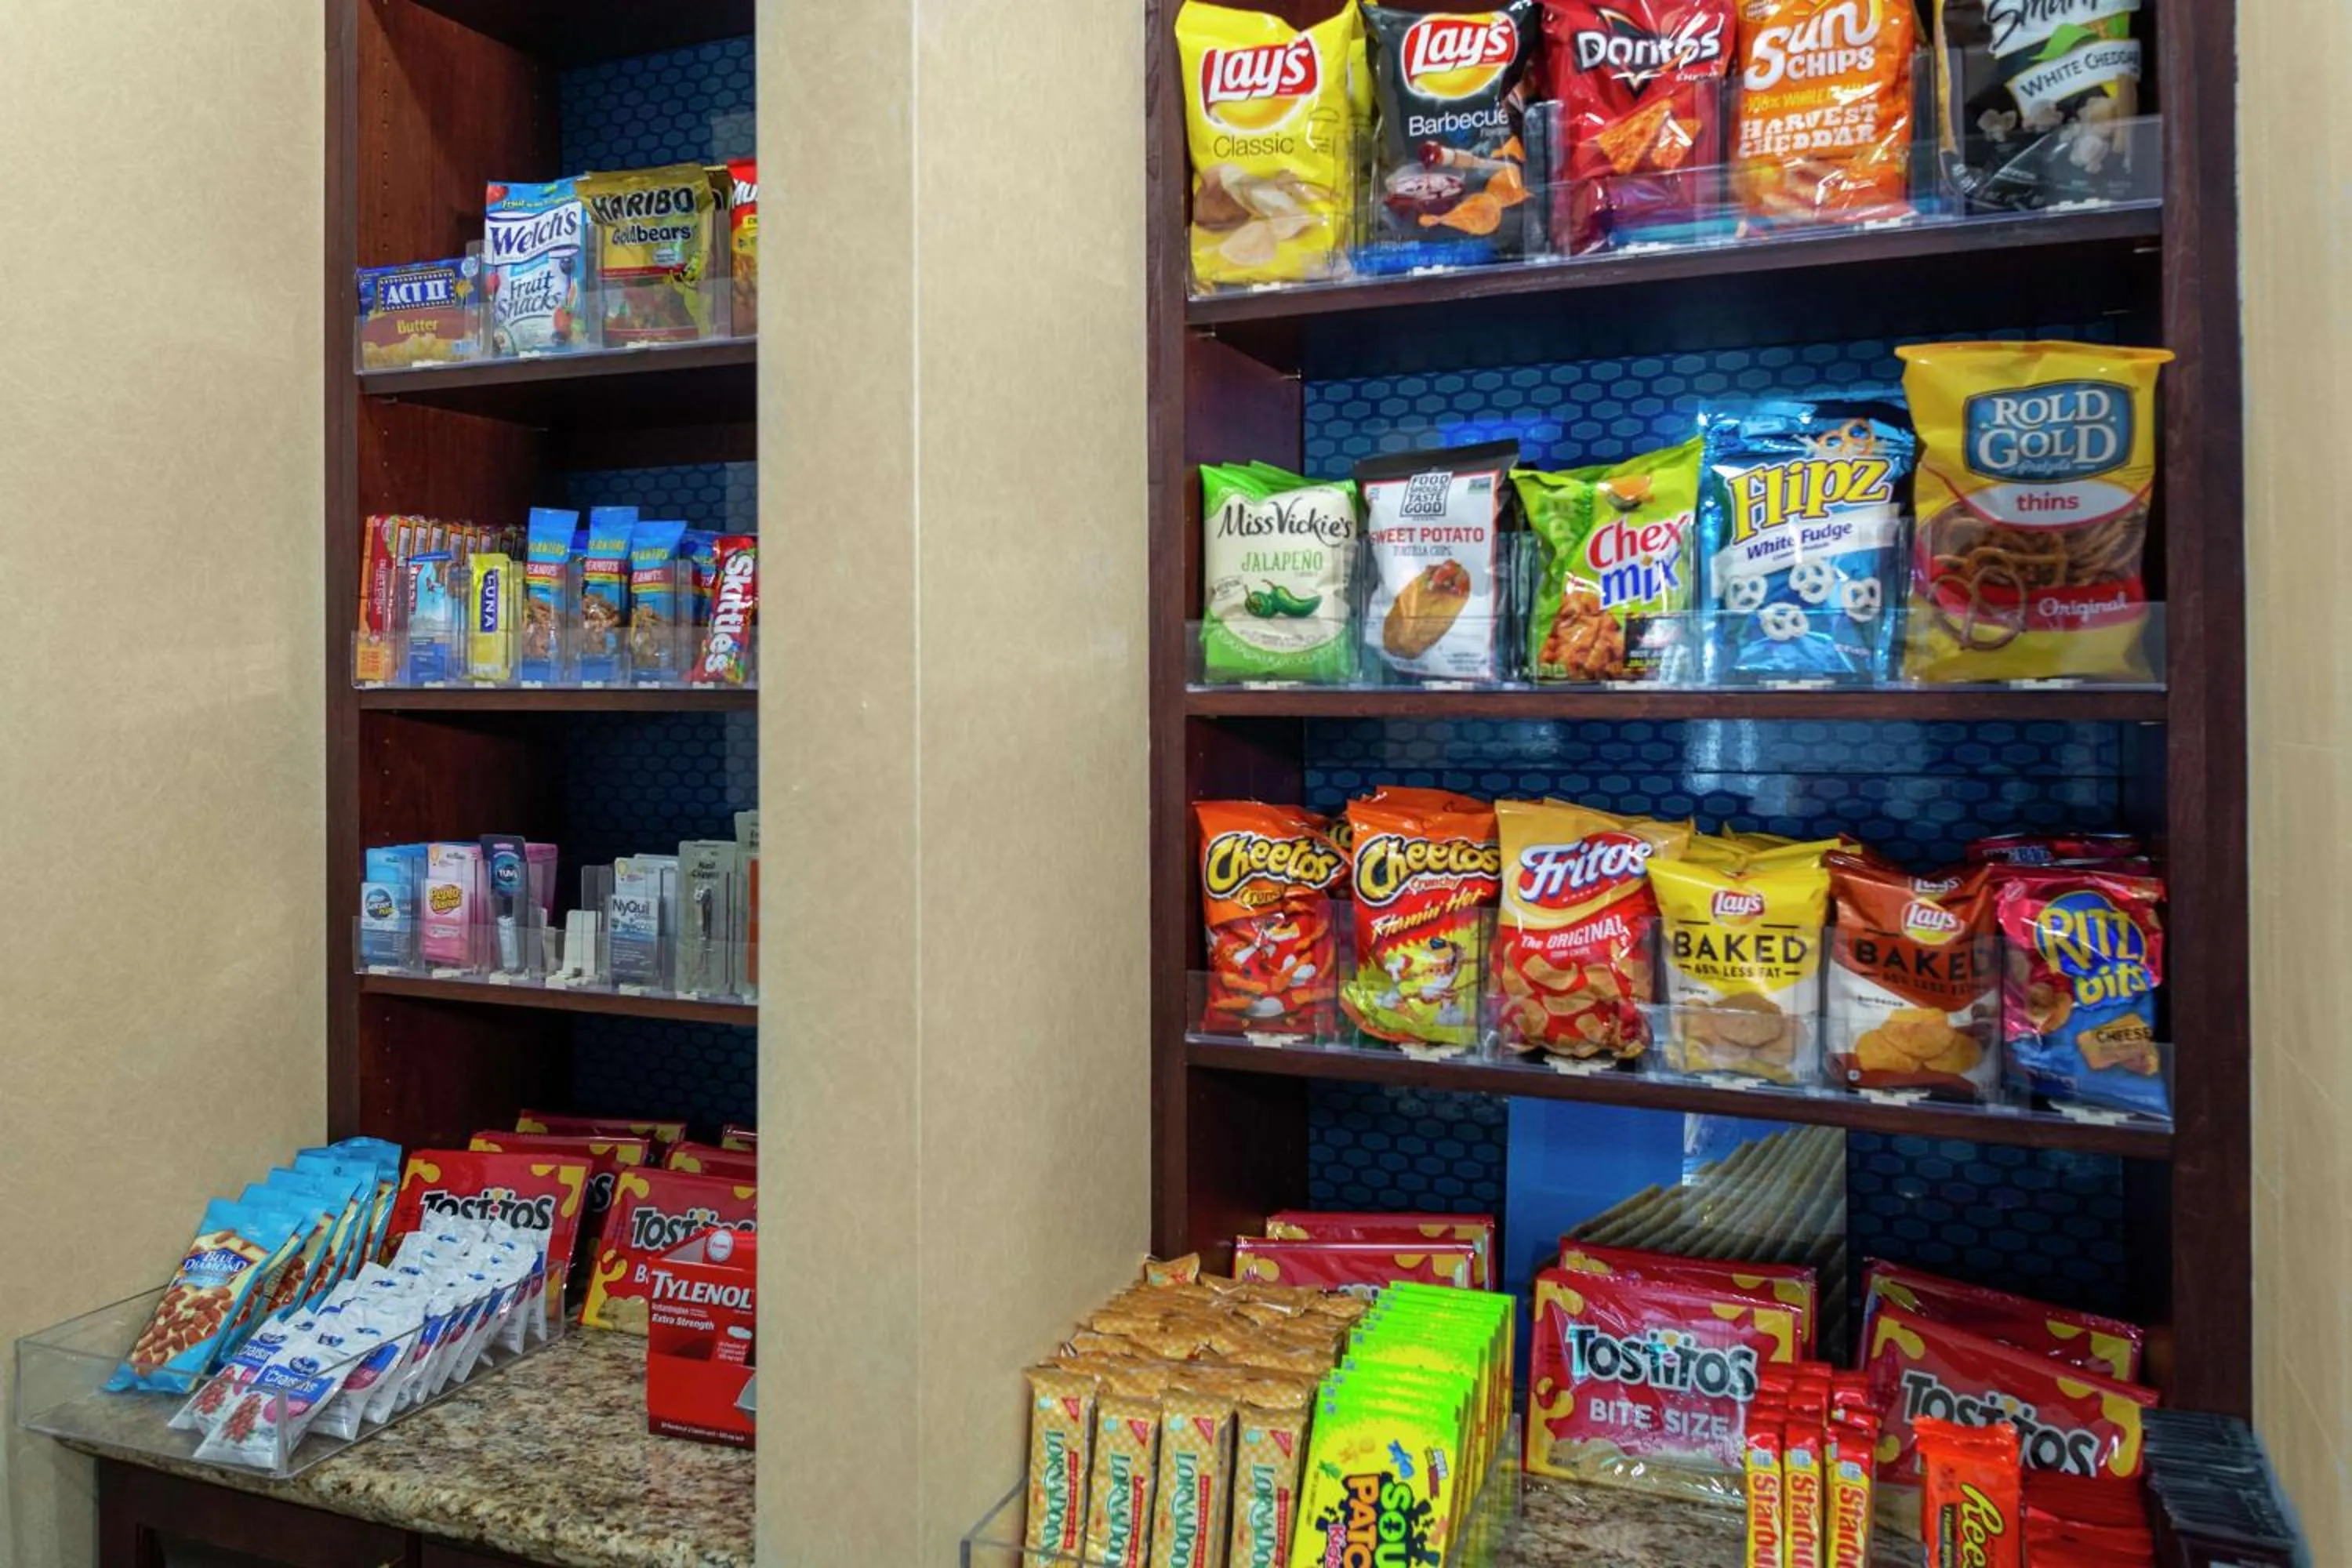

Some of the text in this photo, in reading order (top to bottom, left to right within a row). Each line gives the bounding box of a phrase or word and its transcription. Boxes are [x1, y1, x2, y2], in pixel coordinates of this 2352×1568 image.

[1410, 21, 1510, 76] Lay's
[1577, 28, 1722, 69] Doritos
[1744, 0, 1882, 90] Sun
[1786, 46, 1875, 79] CHIPS
[1208, 41, 1310, 102] Lay's
[2020, 60, 2082, 97] WHITE
[1409, 108, 1509, 137] Barbecue
[1740, 103, 1878, 140] HARVEST
[1214, 132, 1294, 158] Classic
[1739, 125, 1876, 158] CHEDDAR
[591, 187, 695, 223] HARIBO
[489, 207, 577, 256] Welch's
[612, 224, 691, 245] Goldbears
[387, 279, 448, 305] ACT II
[510, 270, 555, 301] Fruit
[496, 291, 561, 320] Snacks
[397, 320, 439, 335] Butter
[1992, 389, 2111, 429] ROLD
[1978, 424, 2117, 469] GOLD
[1408, 493, 1443, 503] TASTE
[1412, 475, 1449, 485] FOOD
[1404, 502, 1442, 514] GOOD
[1728, 459, 1890, 546] Flipz
[2016, 491, 2080, 511] thins
[1217, 496, 1353, 547] Miss Vickie's
[1420, 526, 1484, 543] POTATO
[1589, 514, 1690, 568] Chex
[1747, 535, 1795, 559] White
[1801, 522, 1853, 542] Fudge
[1241, 550, 1323, 572] JALAPEÑO
[1602, 551, 1682, 607] mix
[485, 574, 495, 627] LUNA
[705, 553, 753, 674] Skittles
[2038, 591, 2129, 623] Original
[1207, 836, 1340, 892] Cheetos
[1359, 839, 1501, 900] Cheetos
[1519, 840, 1653, 901] Fritos
[1371, 887, 1487, 943] Flamin' Hot
[1715, 890, 1762, 915] Lay's
[1521, 914, 1628, 949] The ORIGINAL
[1674, 931, 1806, 964] BAKED
[2038, 908, 2140, 973] RITZ
[1723, 966, 1753, 978] LESS
[1759, 967, 1781, 978] FAT
[2078, 963, 2147, 1004] bits
[2096, 1027, 2153, 1044] CHEESE
[631, 1207, 756, 1250] TOST
[183, 1258, 248, 1272] DIAMOND
[651, 1269, 753, 1309] TYLENOL
[652, 1313, 715, 1330] Extra Strength
[1566, 1324, 1759, 1401] TOSTITOS
[1589, 1397, 1730, 1440] BITE SIZE
[1902, 1370, 2100, 1477] TOSTOS
